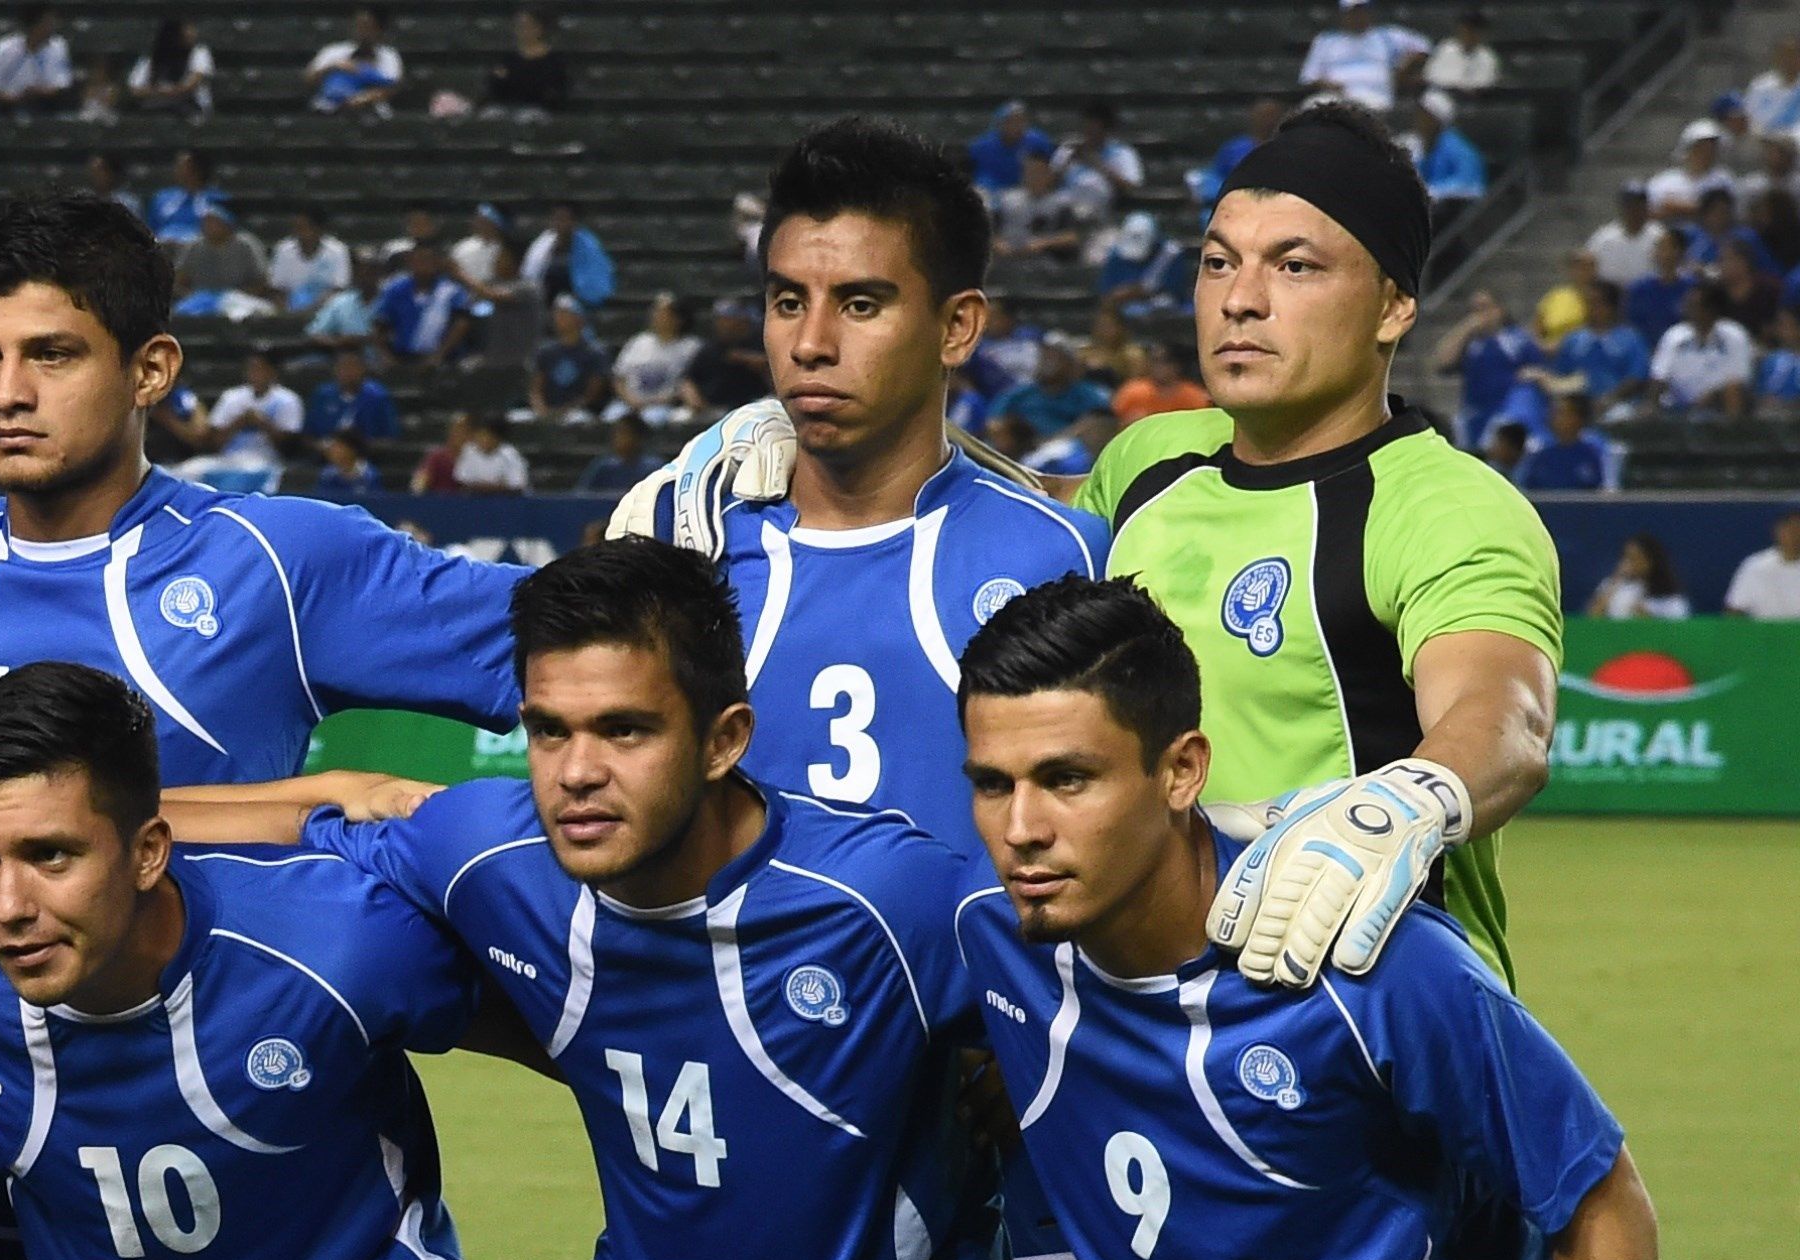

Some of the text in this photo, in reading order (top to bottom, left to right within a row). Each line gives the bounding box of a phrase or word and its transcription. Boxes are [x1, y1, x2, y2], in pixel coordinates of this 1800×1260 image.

[1254, 624, 1274, 643] ES
[807, 663, 882, 805] 3
[1551, 720, 1726, 769] URAL
[1218, 847, 1269, 944] ELITE
[488, 946, 537, 980] mitre
[986, 989, 1027, 1024] mitre
[604, 1048, 728, 1188] 14
[77, 1143, 222, 1259] 10
[1103, 1130, 1172, 1260] 9
